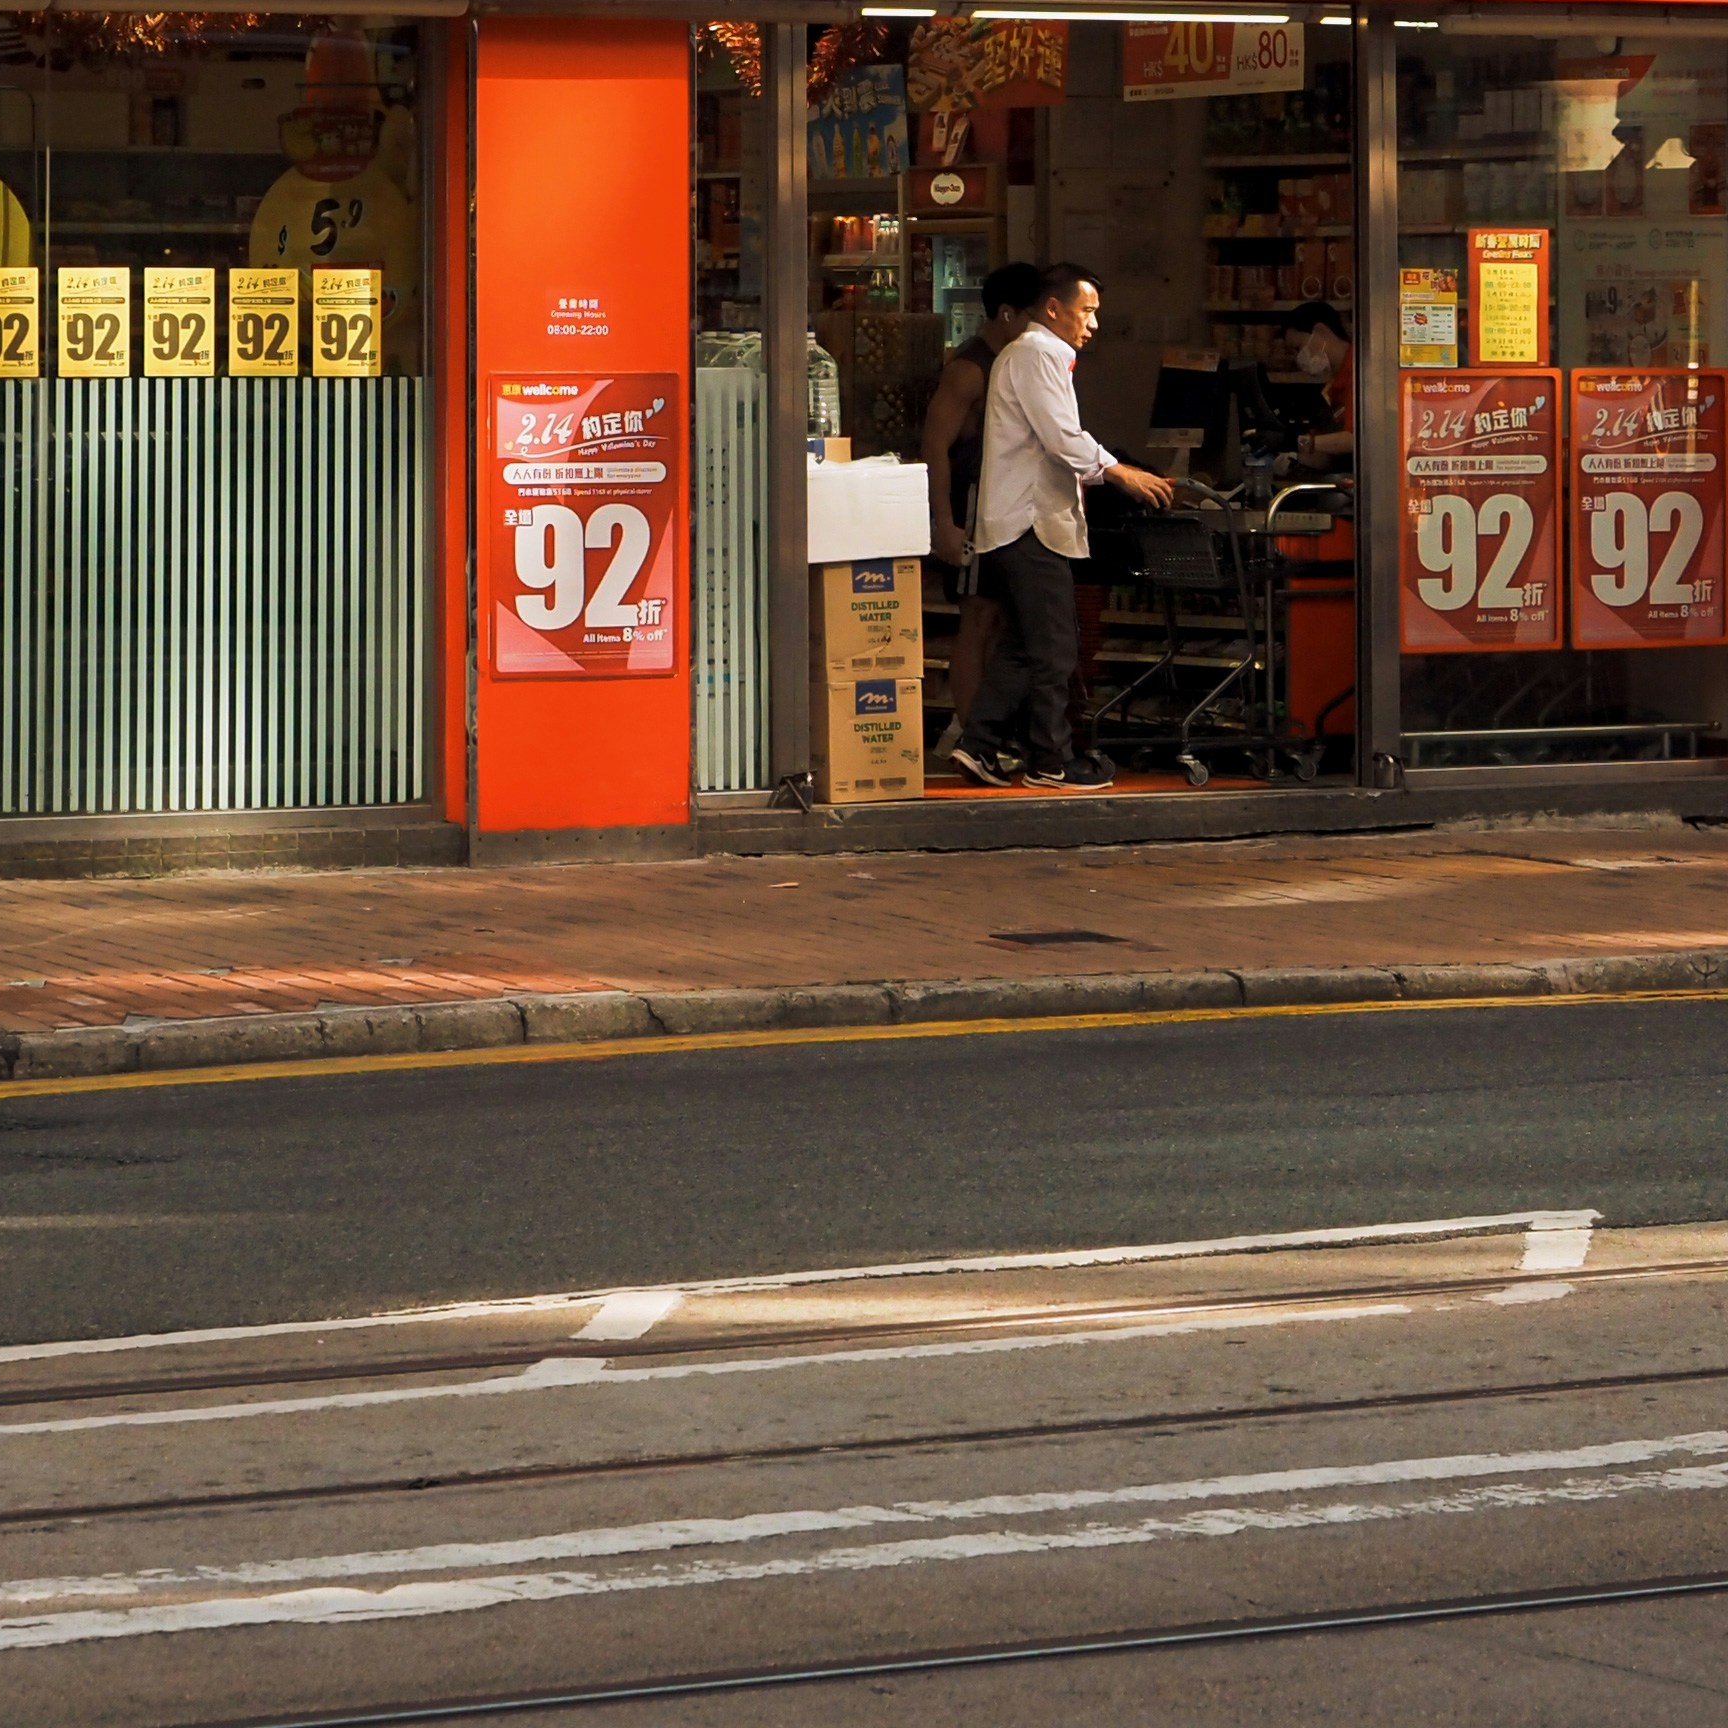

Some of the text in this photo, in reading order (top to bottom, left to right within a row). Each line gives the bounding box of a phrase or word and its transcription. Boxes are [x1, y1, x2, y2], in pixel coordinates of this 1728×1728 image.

[1237, 52, 1258, 71] HK$
[1258, 29, 1287, 70] 80
[584, 310, 606, 319] Hours
[66, 313, 120, 361] 92
[152, 313, 206, 361] 92
[237, 313, 290, 361] 92
[320, 313, 373, 361] 92
[547, 325, 609, 336] 08:00-22:00
[522, 384, 578, 396] wellcome
[515, 410, 644, 445] 2.14 約定你
[1418, 407, 1528, 439] 2.14 約定你
[1591, 408, 1641, 437] 2.14
[642, 439, 656, 449] Day
[1417, 493, 1534, 611] 92
[1523, 582, 1544, 606] 折
[1591, 491, 1703, 607] 92
[1693, 579, 1712, 602] 折
[514, 502, 651, 630] 92
[637, 599, 662, 625] 折
[851, 600, 900, 611] DISTILLED
[859, 613, 892, 622] WATER
[583, 633, 596, 643] All
[596, 633, 621, 643] items
[854, 722, 902, 732] DISTILLED
[862, 734, 894, 743] WATER
